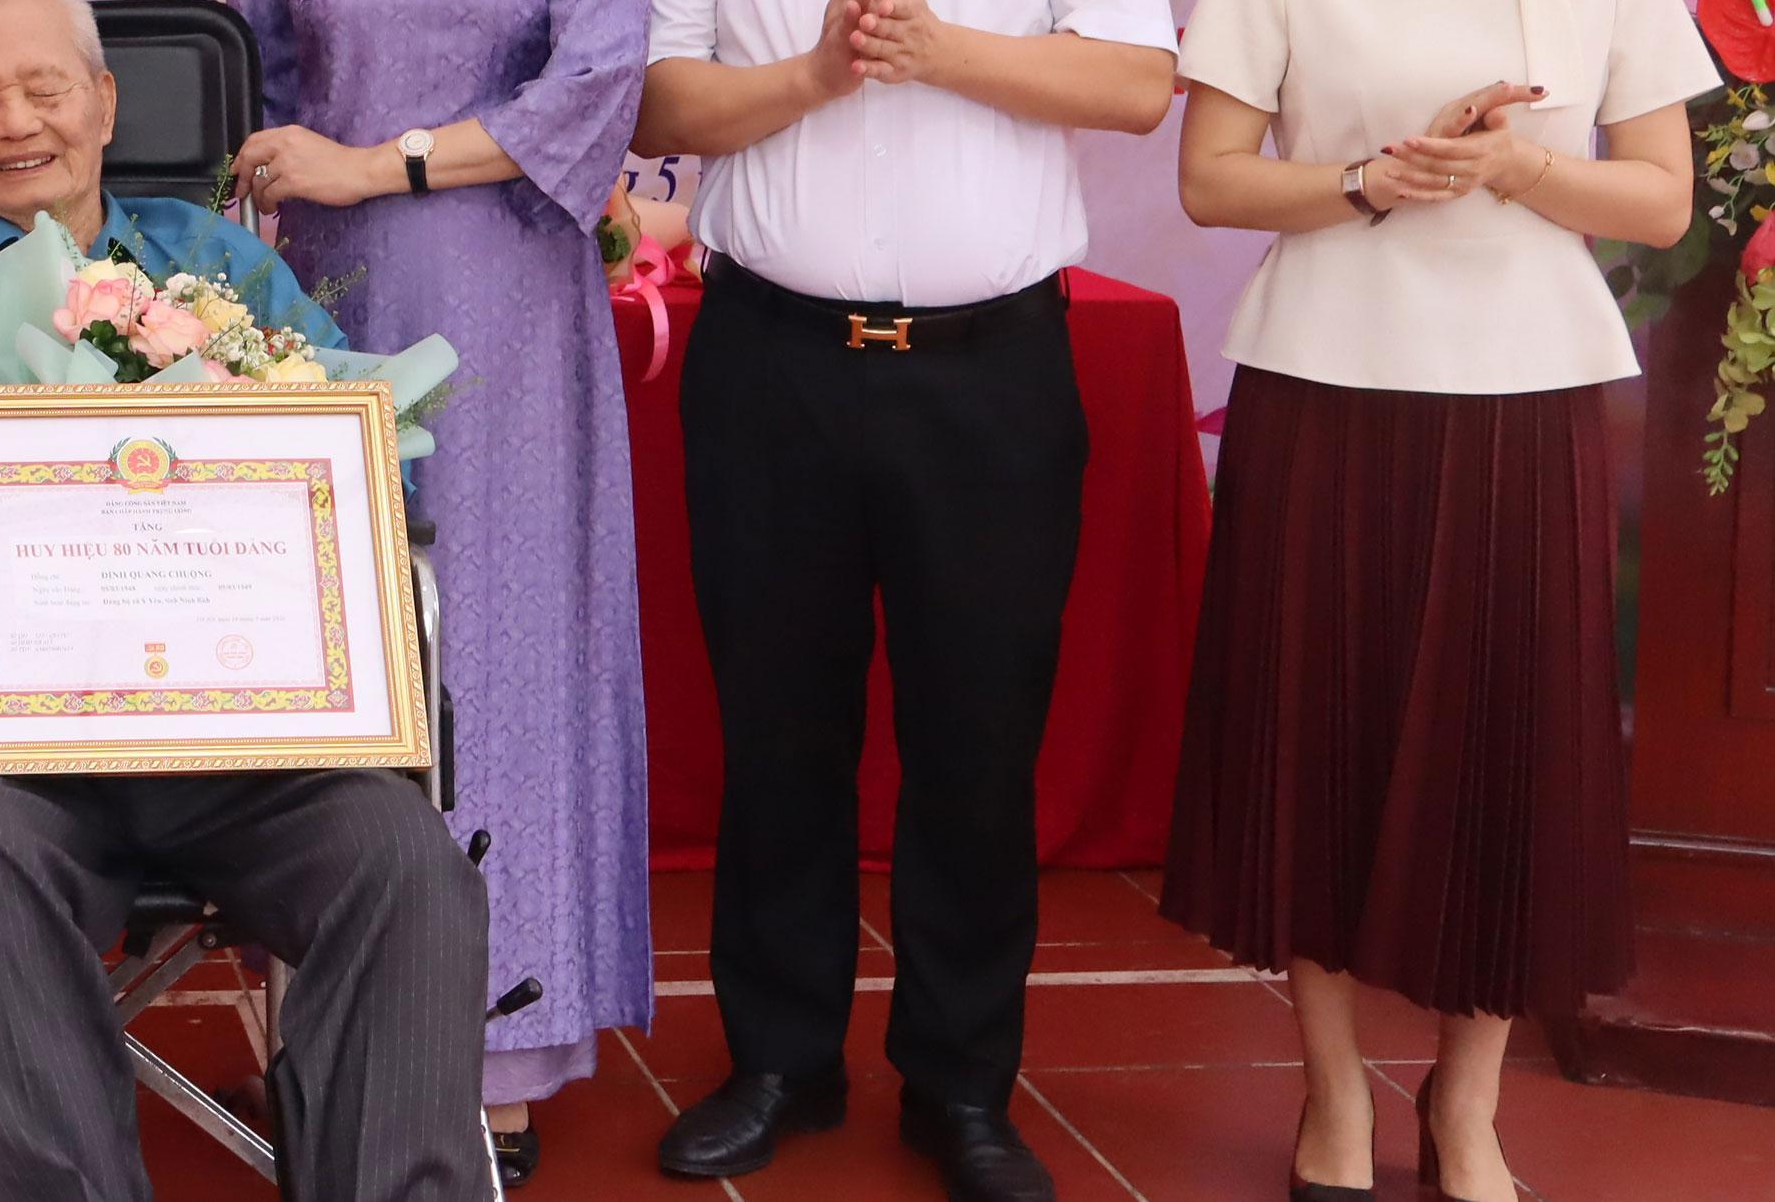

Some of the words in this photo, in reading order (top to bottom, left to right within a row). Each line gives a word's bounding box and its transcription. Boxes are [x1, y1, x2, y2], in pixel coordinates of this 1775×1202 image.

[15, 542, 56, 558] HUY
[112, 541, 132, 557] 80
[135, 537, 180, 556] NĂM
